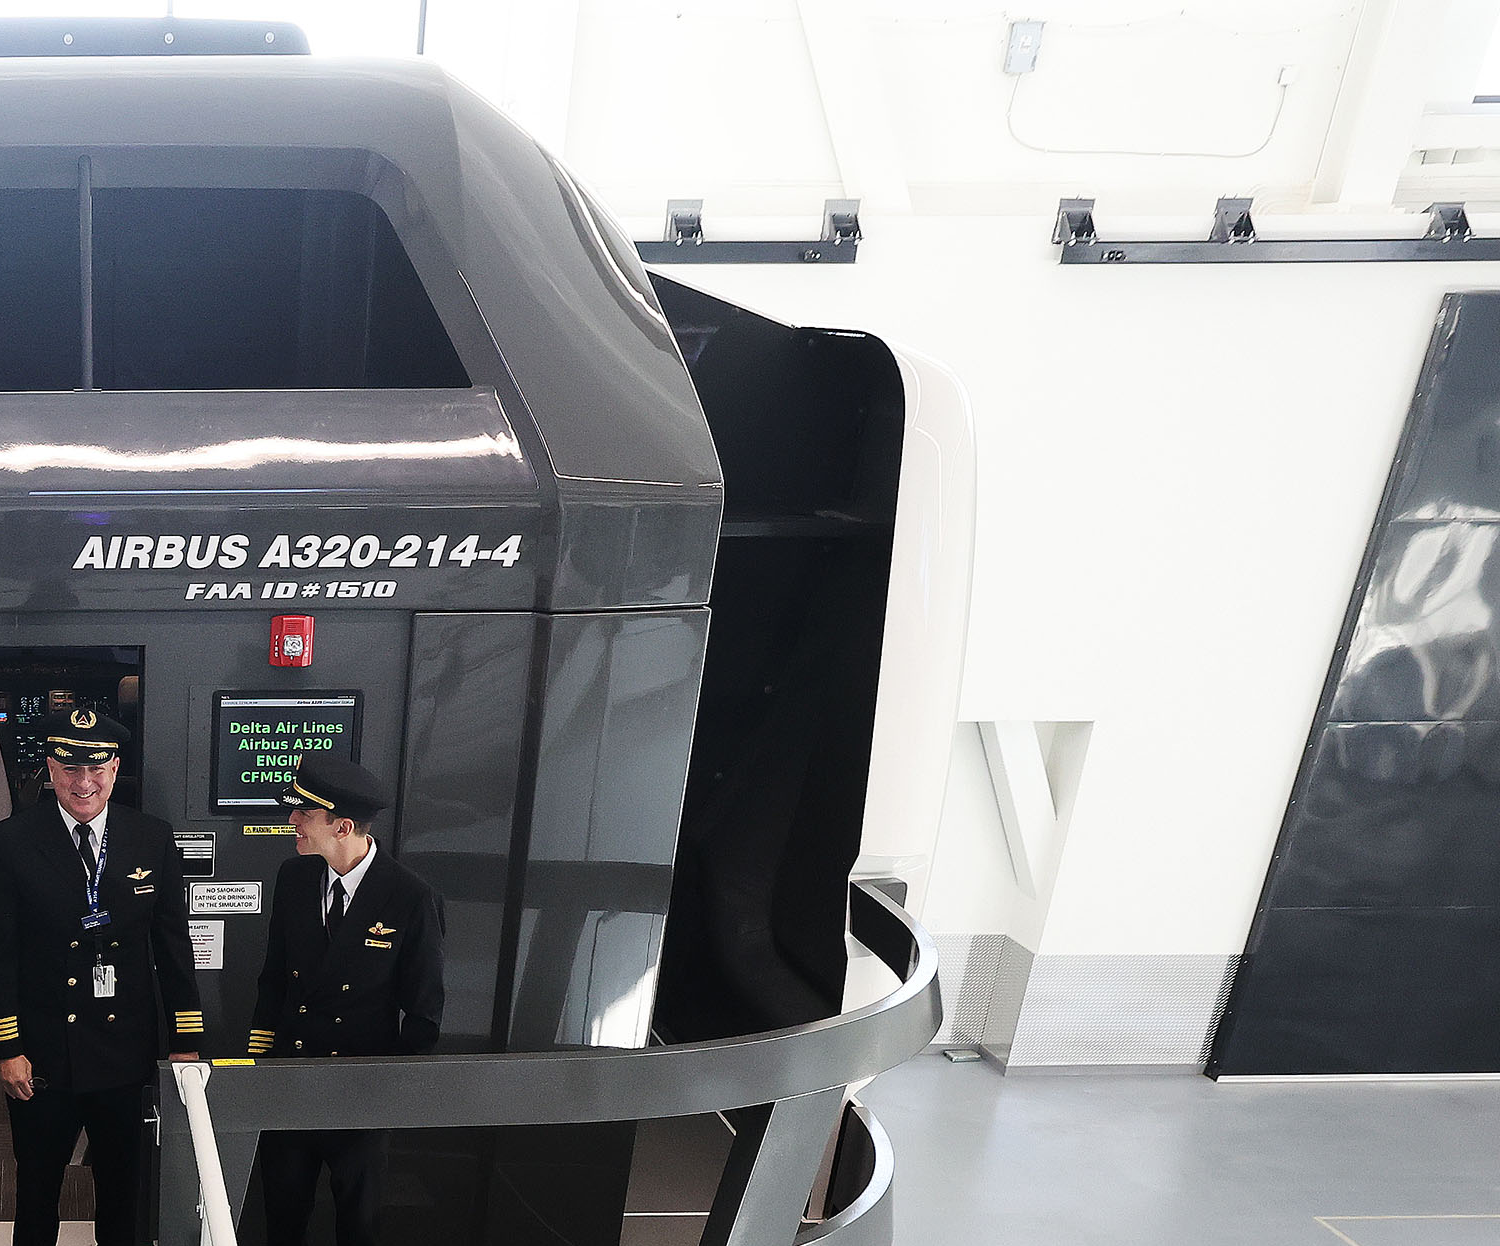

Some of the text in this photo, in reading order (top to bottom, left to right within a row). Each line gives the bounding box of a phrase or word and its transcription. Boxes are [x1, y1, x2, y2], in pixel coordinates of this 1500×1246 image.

[72, 534, 523, 569] AIRBUS A320-214-4
[185, 583, 252, 600] FAA
[229, 722, 344, 734] Delta Air Lines
[238, 738, 333, 751] Airbus A320
[256, 754, 300, 767] ENGIN
[241, 771, 297, 783] CFM56-
